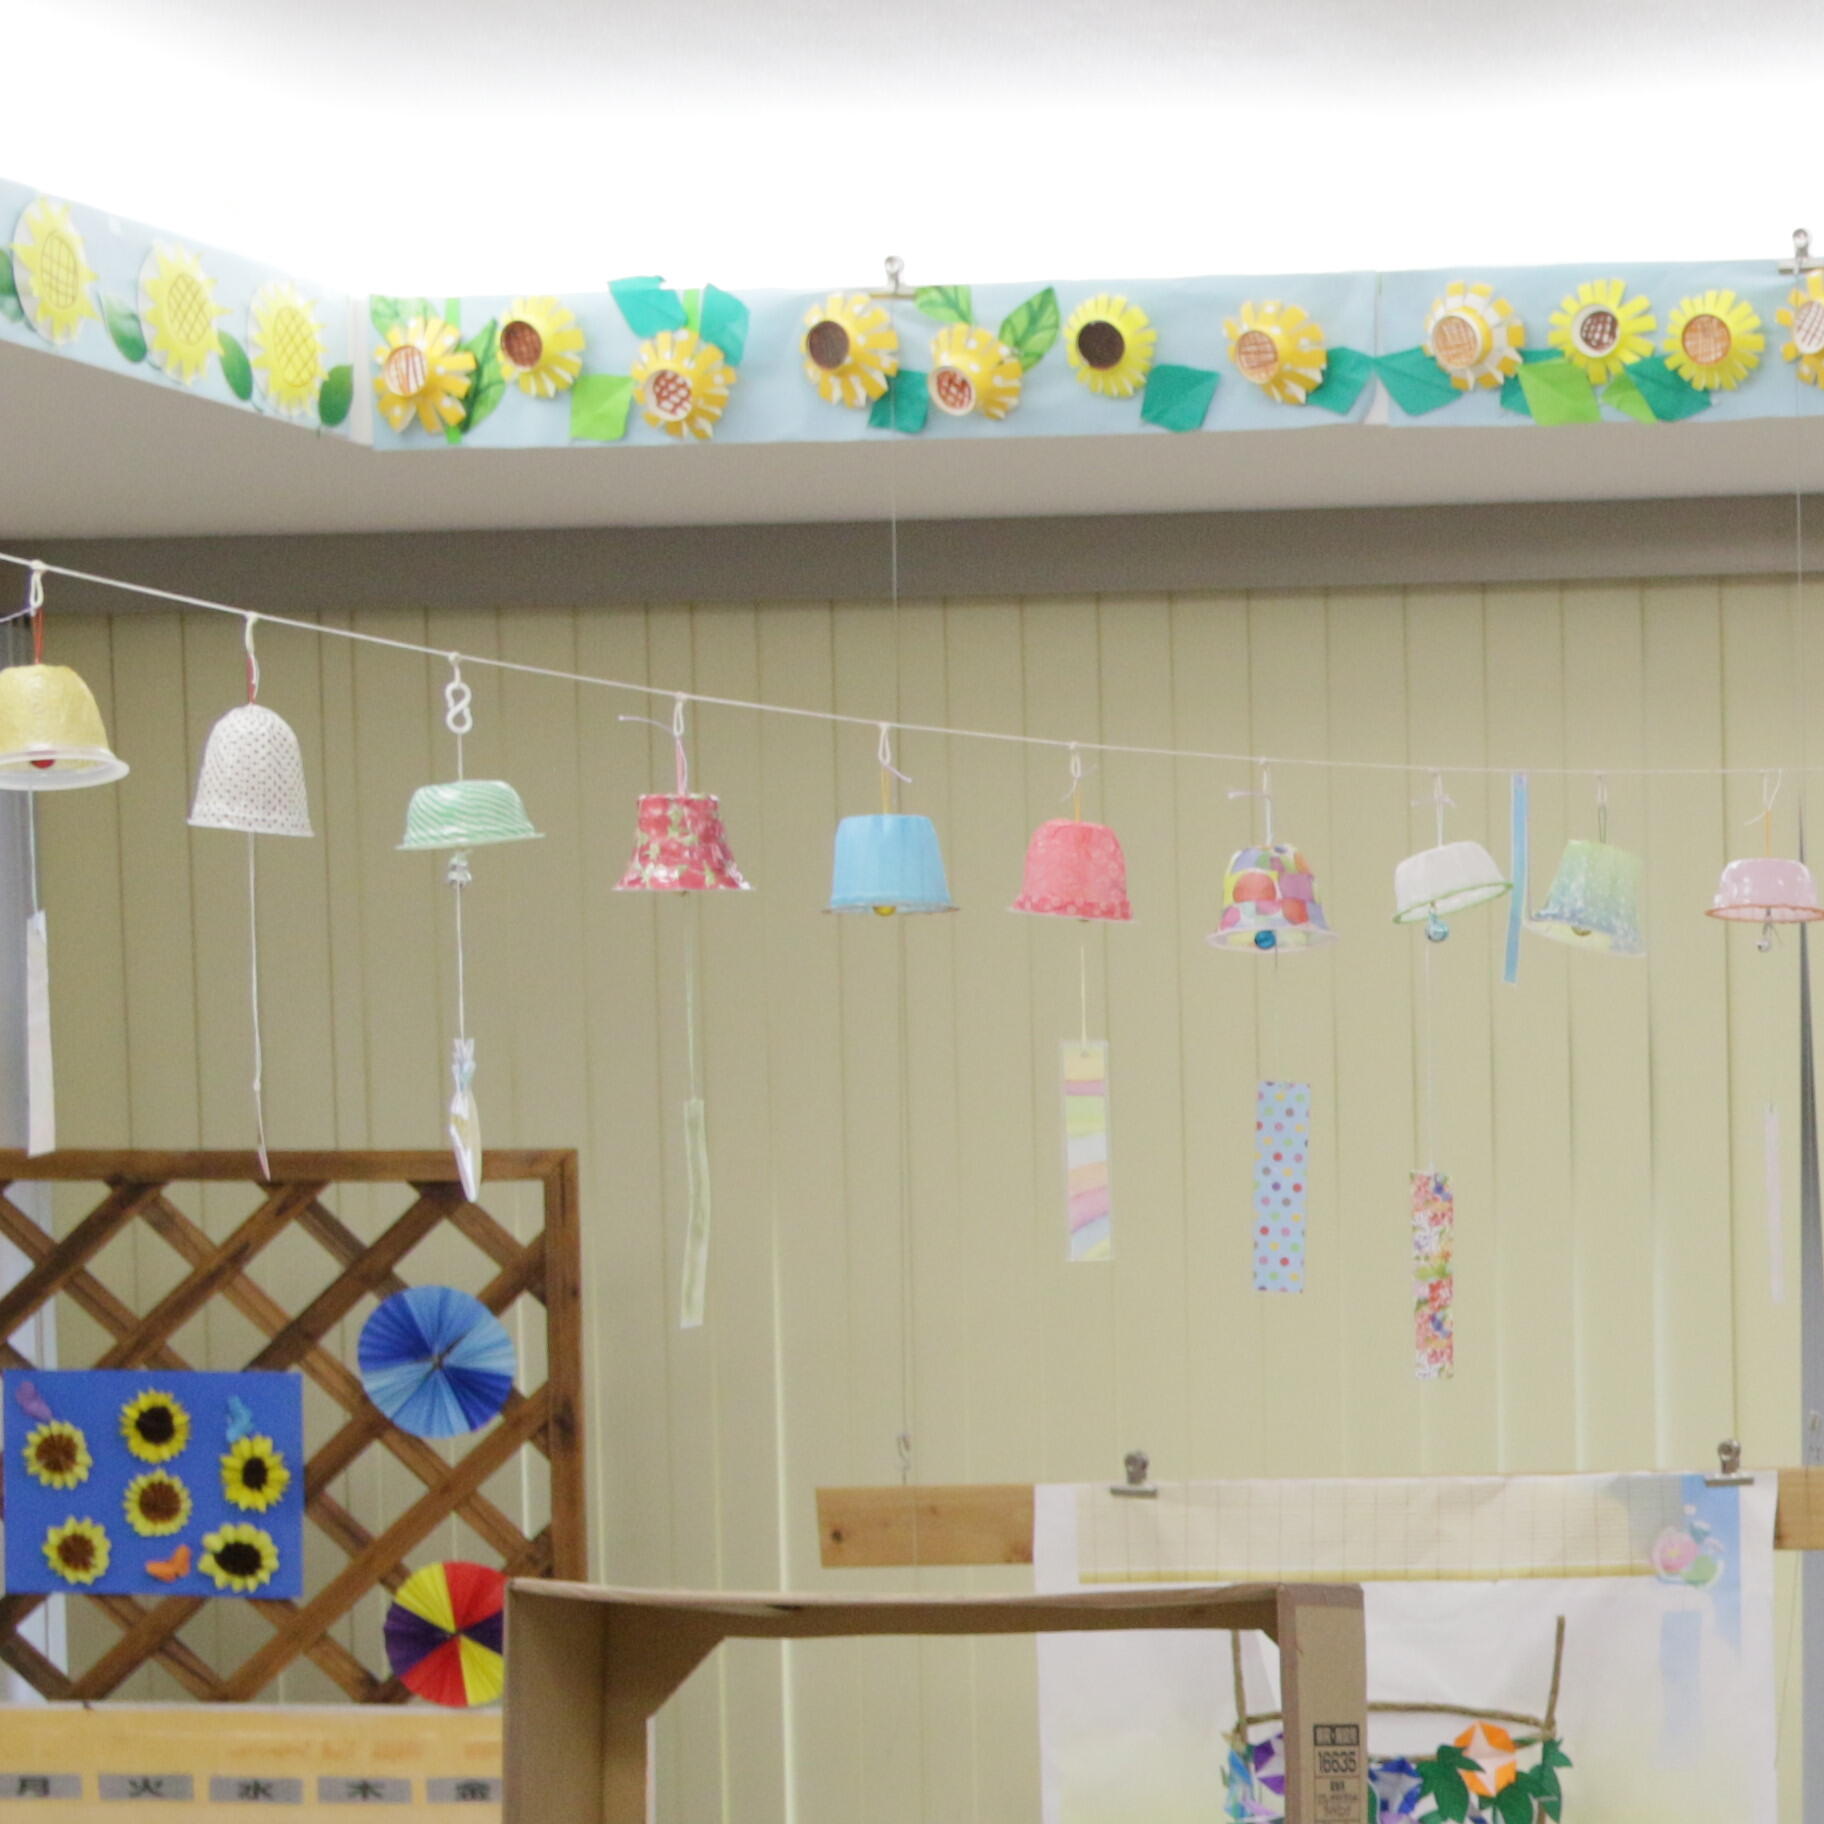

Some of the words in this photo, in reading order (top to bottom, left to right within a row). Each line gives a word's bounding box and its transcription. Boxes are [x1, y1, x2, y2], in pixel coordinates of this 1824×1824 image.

[17, 1776, 50, 1796] 月
[129, 1777, 163, 1797] 火
[239, 1780, 273, 1800] 水
[351, 1780, 382, 1800] 木
[456, 1781, 490, 1801] 金
